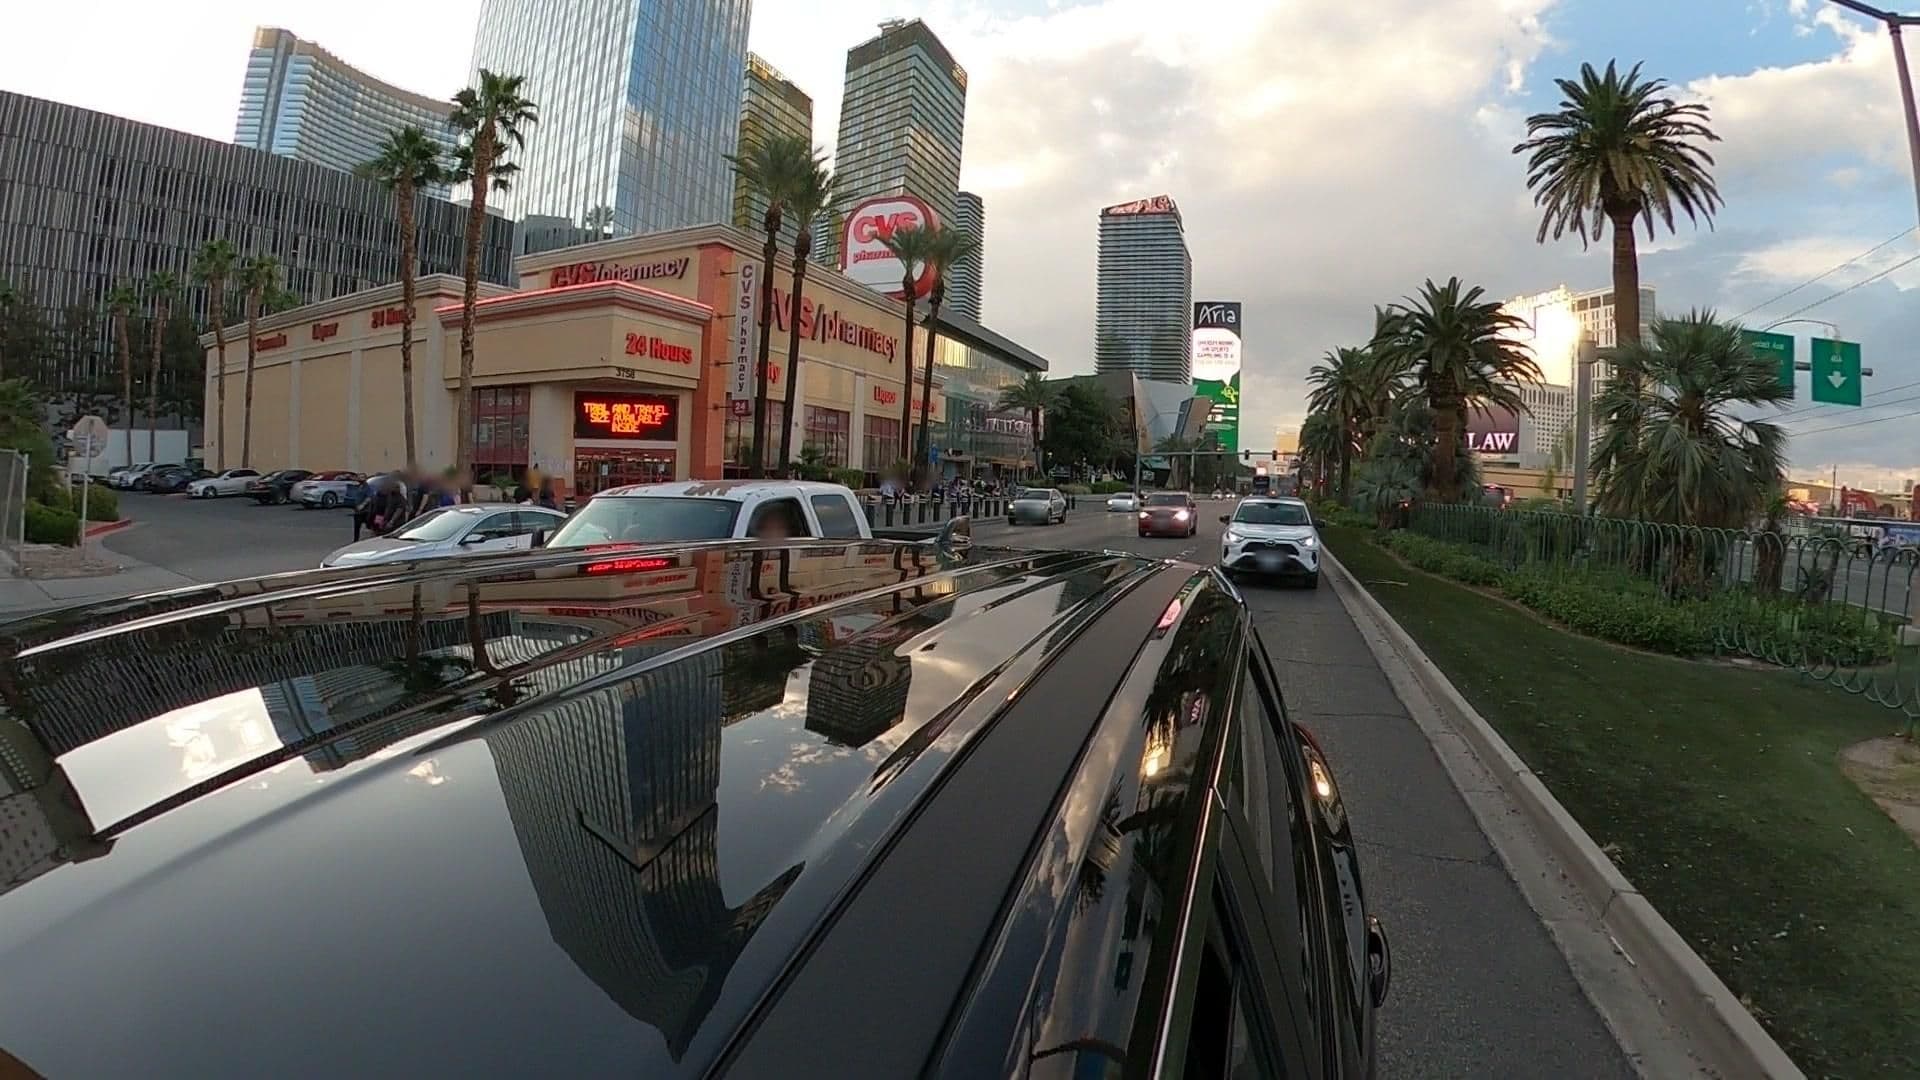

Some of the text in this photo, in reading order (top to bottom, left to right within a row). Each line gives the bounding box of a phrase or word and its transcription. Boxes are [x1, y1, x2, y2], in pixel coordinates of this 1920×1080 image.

[853, 212, 917, 243] CVS
[757, 286, 898, 364] VS/pharmacy
[1198, 304, 1237, 325] Aria
[737, 265, 753, 392] CVS pharmacy
[625, 333, 692, 364] 24 Hours
[612, 403, 631, 414] AND
[634, 404, 669, 416] TRAVEL
[734, 402, 746, 412] 24
[611, 422, 640, 433] INSIDE
[1466, 432, 1515, 451] LAW
